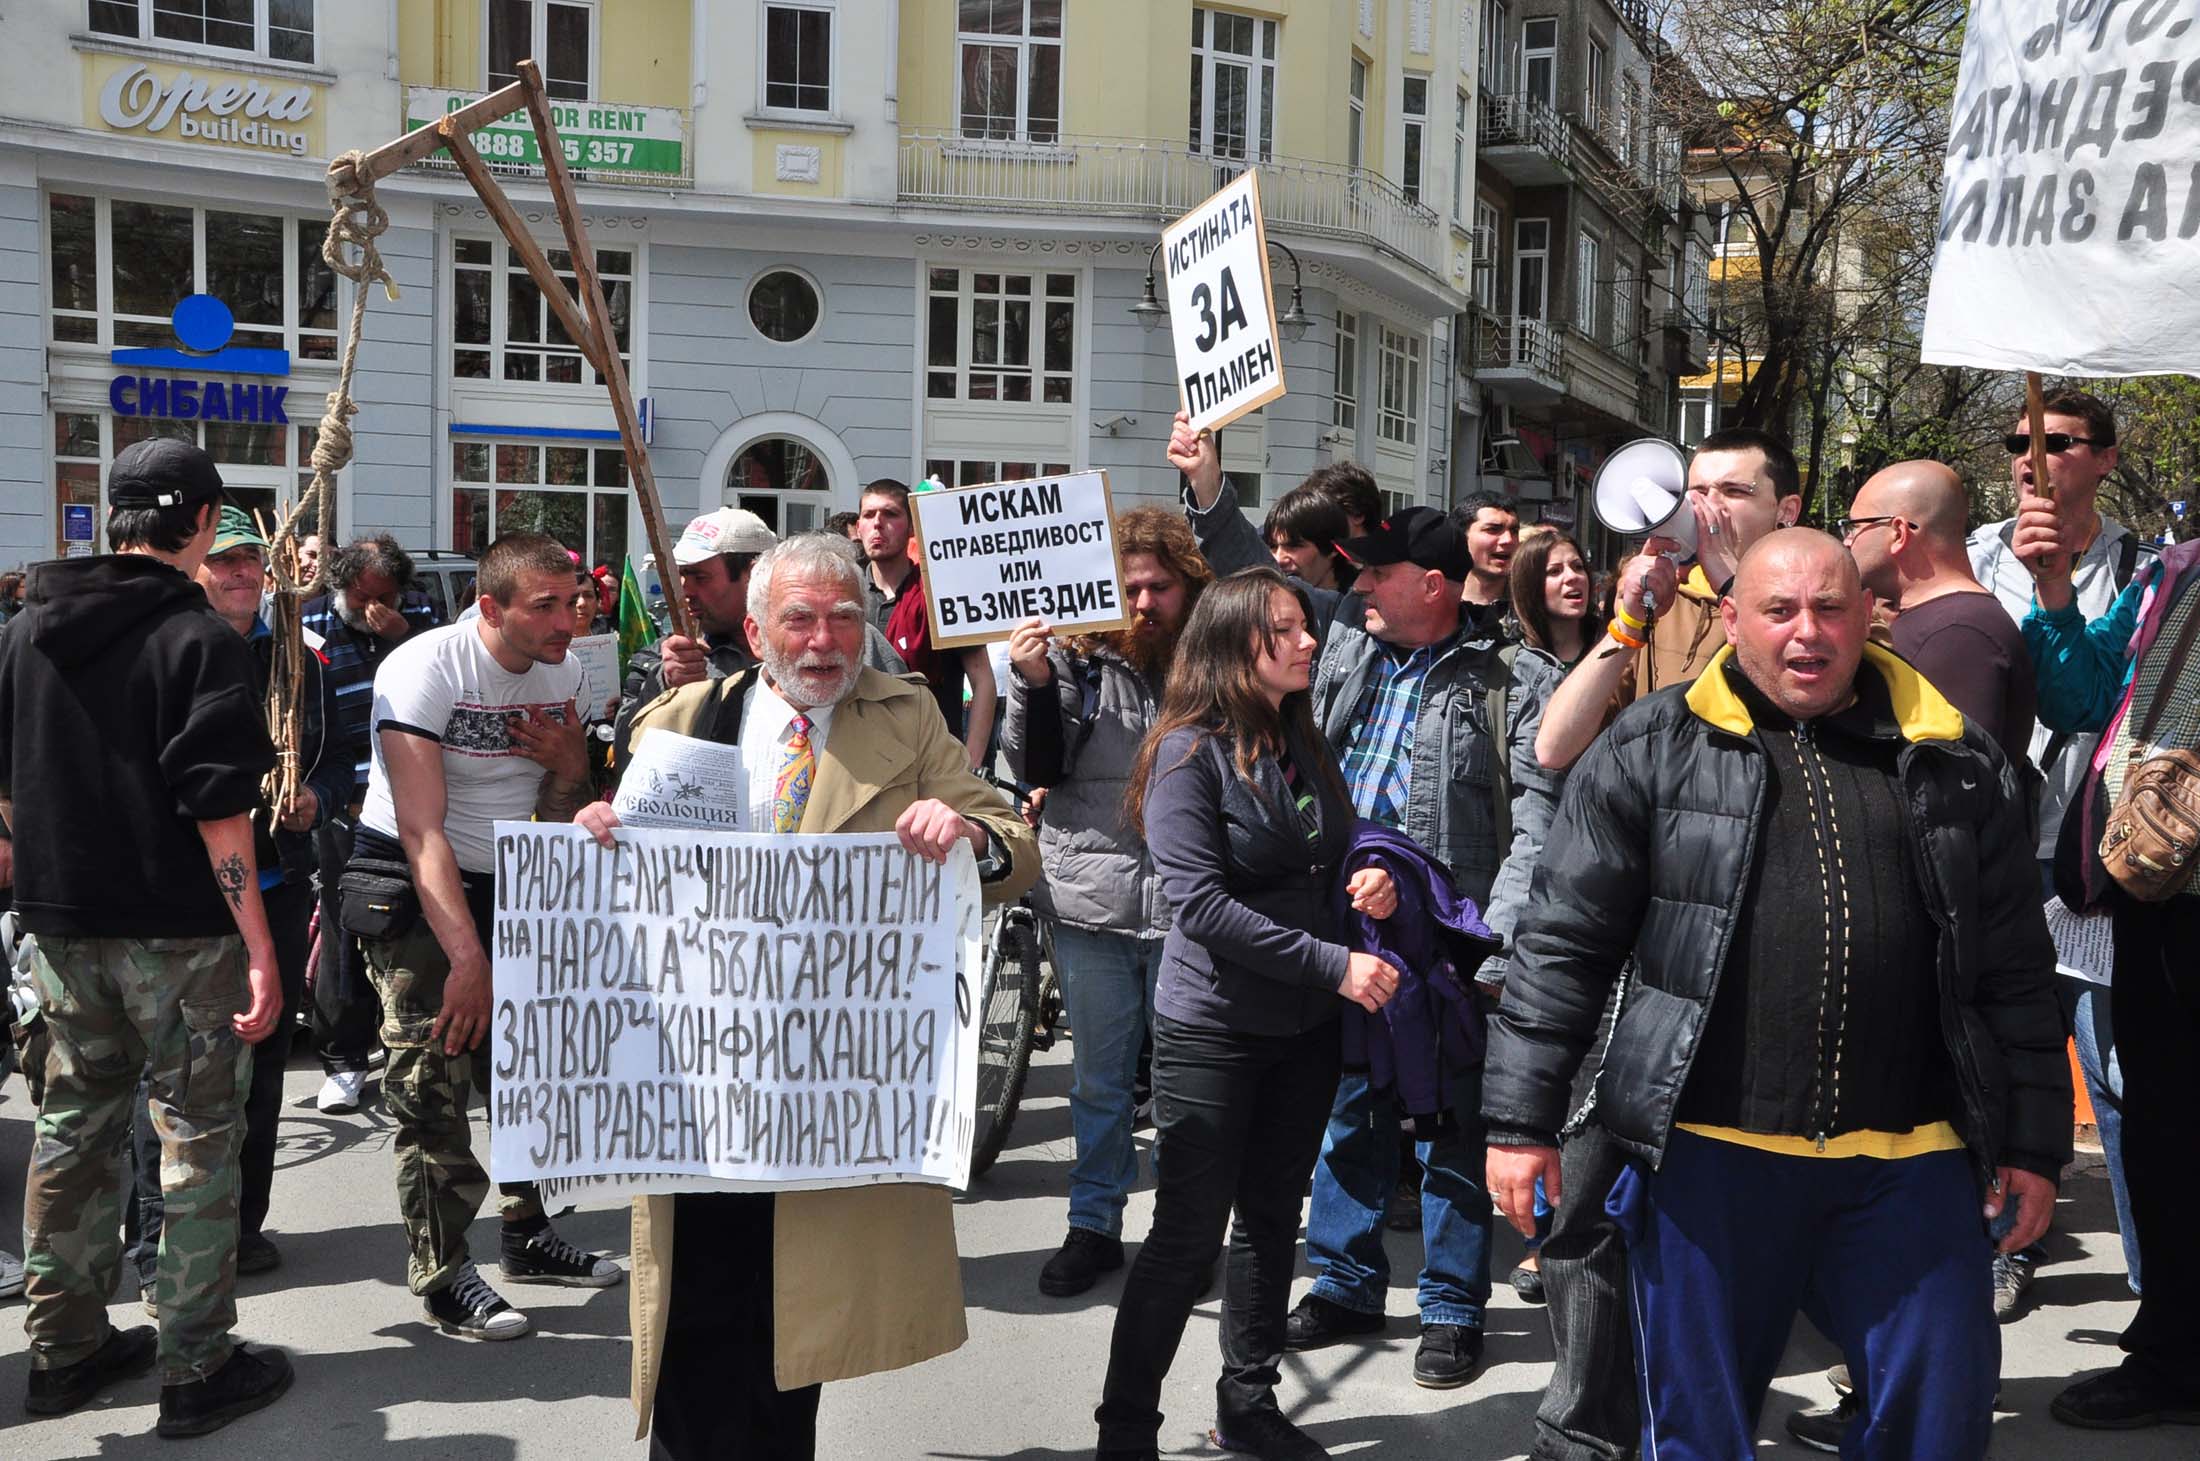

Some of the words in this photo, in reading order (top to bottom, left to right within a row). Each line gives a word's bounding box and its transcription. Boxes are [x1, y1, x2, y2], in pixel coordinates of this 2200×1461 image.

[99, 62, 313, 133] Opera
[588, 109, 646, 132] RENT
[180, 112, 307, 156] building
[587, 140, 634, 164] 357
[1169, 194, 1252, 279] ИСТИНАТА
[1191, 265, 1248, 353] ЗА
[109, 375, 290, 425] СИБАНК
[959, 483, 1063, 525] ИСКАМ
[929, 520, 1104, 561] СПРАВЕДЛИВОСТ
[999, 559, 1042, 584] ИЛИ
[939, 579, 1116, 627] ВЪЗМЕЗДИЕ
[497, 833, 674, 916] ГРАБИТЕЛИ
[694, 843, 941, 929] УНИЩОЖИТЕЛИ
[497, 917, 532, 958] НА
[535, 916, 685, 996] НАРОДА
[496, 995, 624, 1081] ЗАТВОР
[658, 1001, 936, 1087] КОНФИСКАЦИЯ
[497, 1082, 533, 1128] НА
[529, 1079, 721, 1168] ЗАГРАБЕНИ
